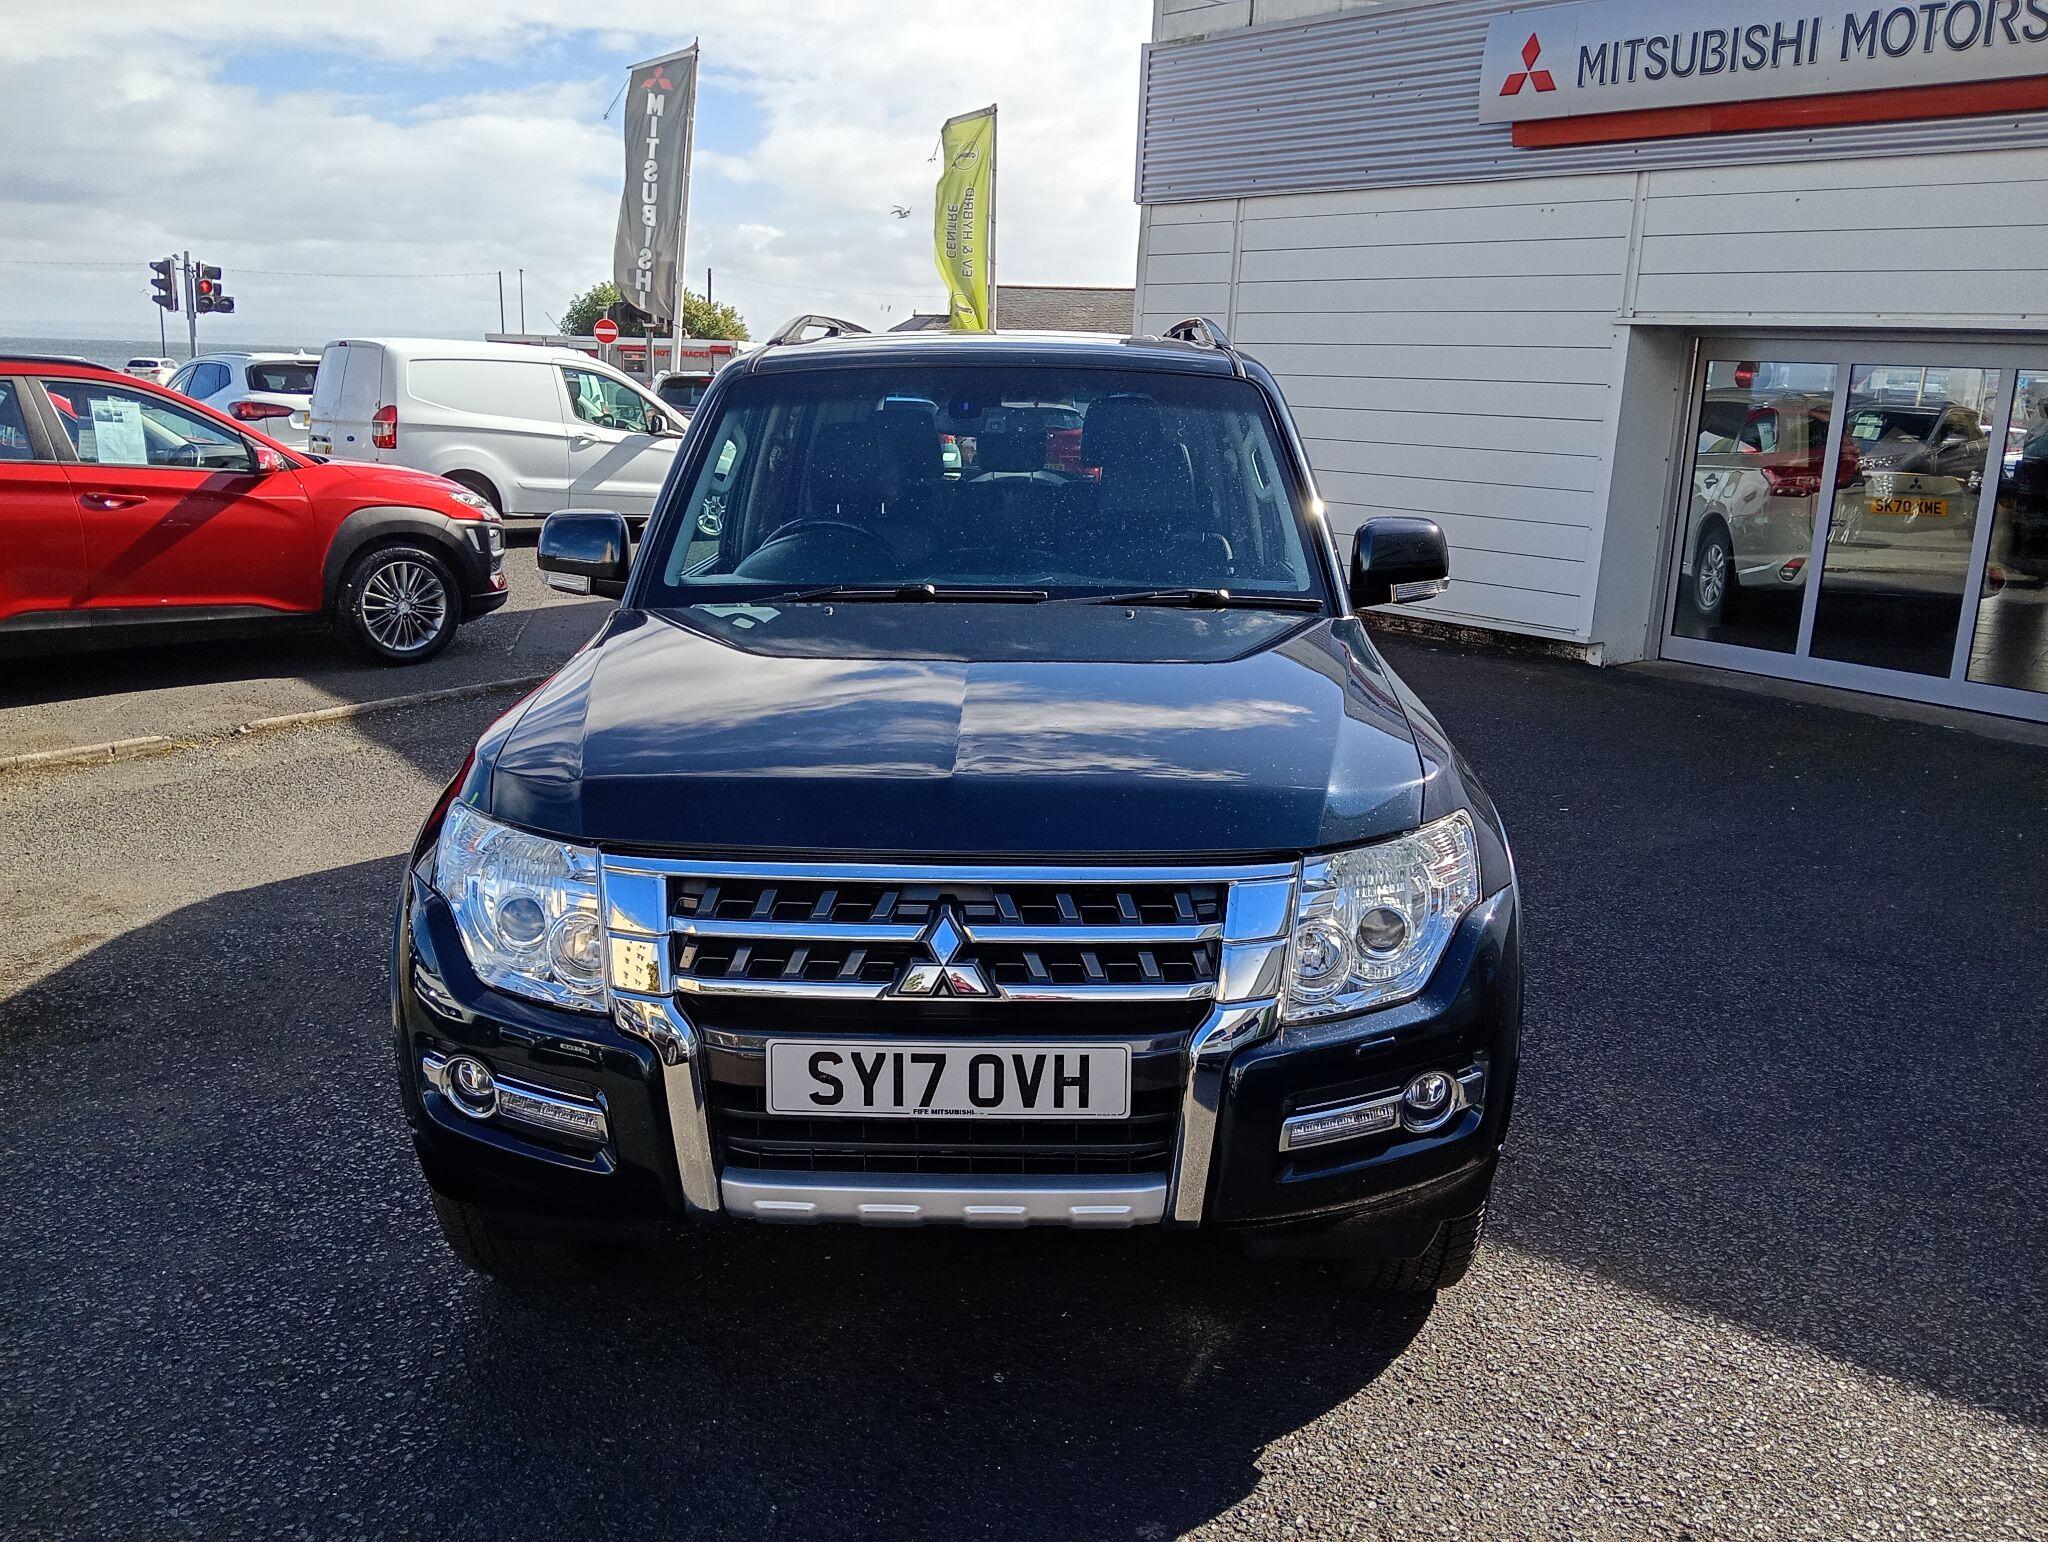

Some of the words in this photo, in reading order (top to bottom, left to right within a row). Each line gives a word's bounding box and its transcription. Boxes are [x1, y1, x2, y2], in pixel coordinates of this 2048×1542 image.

[1577, 16, 1823, 87] MITSUBISHI
[1840, 0, 2048, 61] MOTORS
[1876, 498, 1911, 513] SK70
[808, 1051, 947, 1107] SY17
[968, 1053, 1090, 1108] OVH
